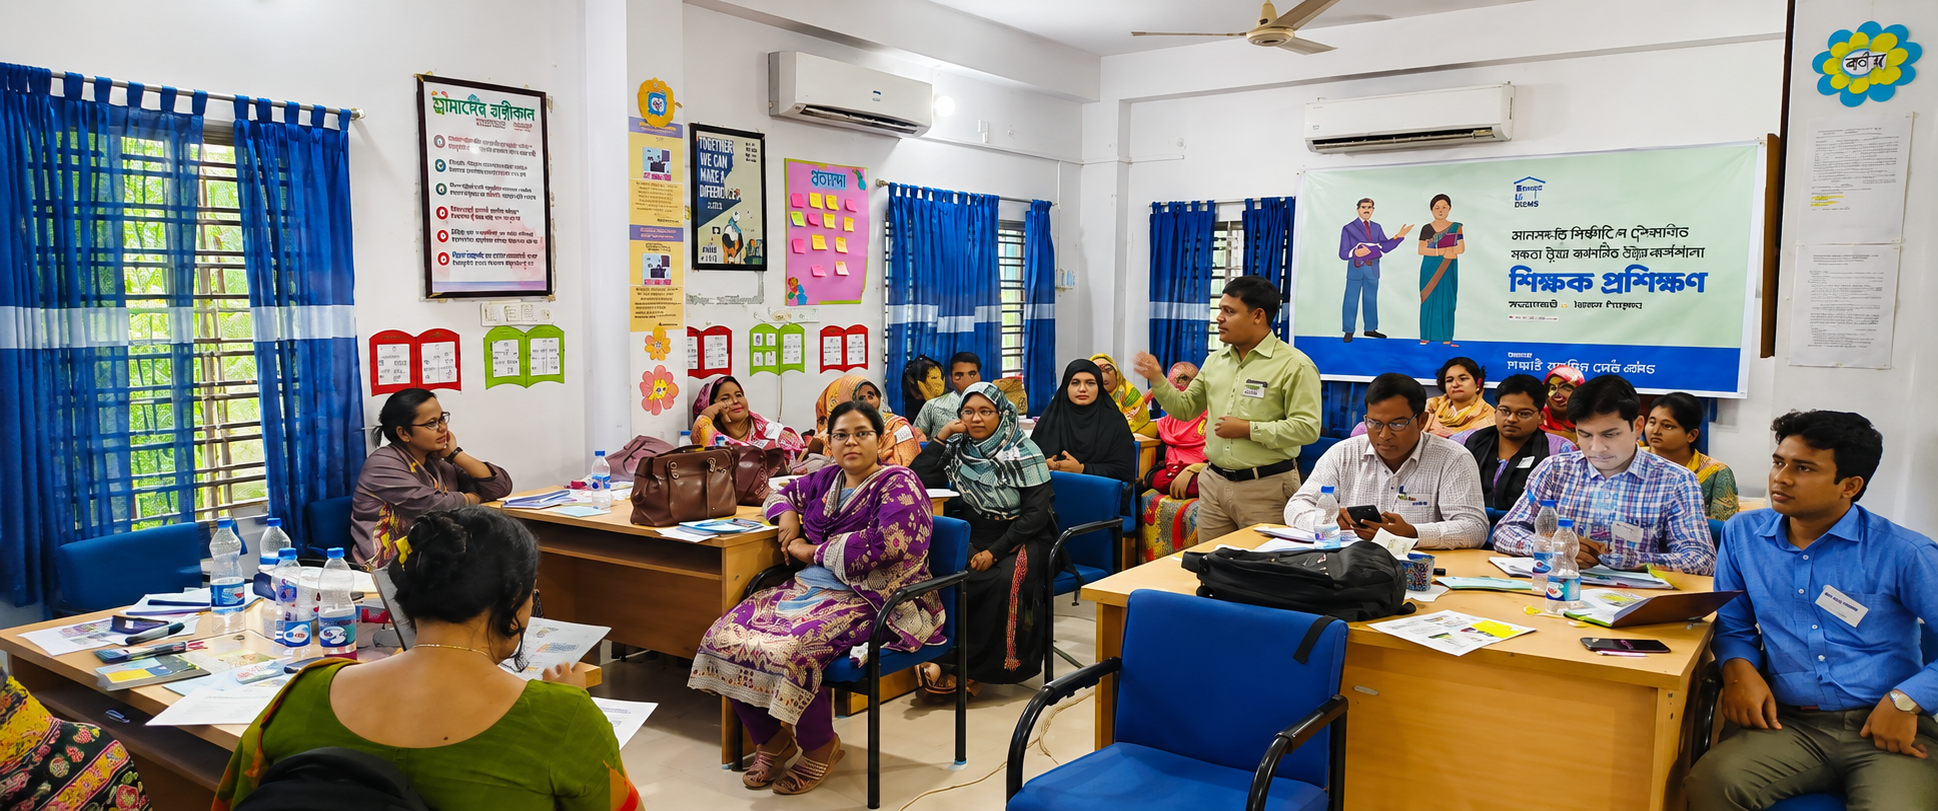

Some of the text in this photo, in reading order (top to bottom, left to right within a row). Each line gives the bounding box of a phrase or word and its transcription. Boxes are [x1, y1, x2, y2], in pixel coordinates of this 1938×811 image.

[700, 136, 733, 153] TOGETHER
[700, 152, 728, 169] WE CAN
[700, 168, 719, 184] MAKE
[1509, 264, 1709, 294] শিক্ষক প্রশিক্ষণ
